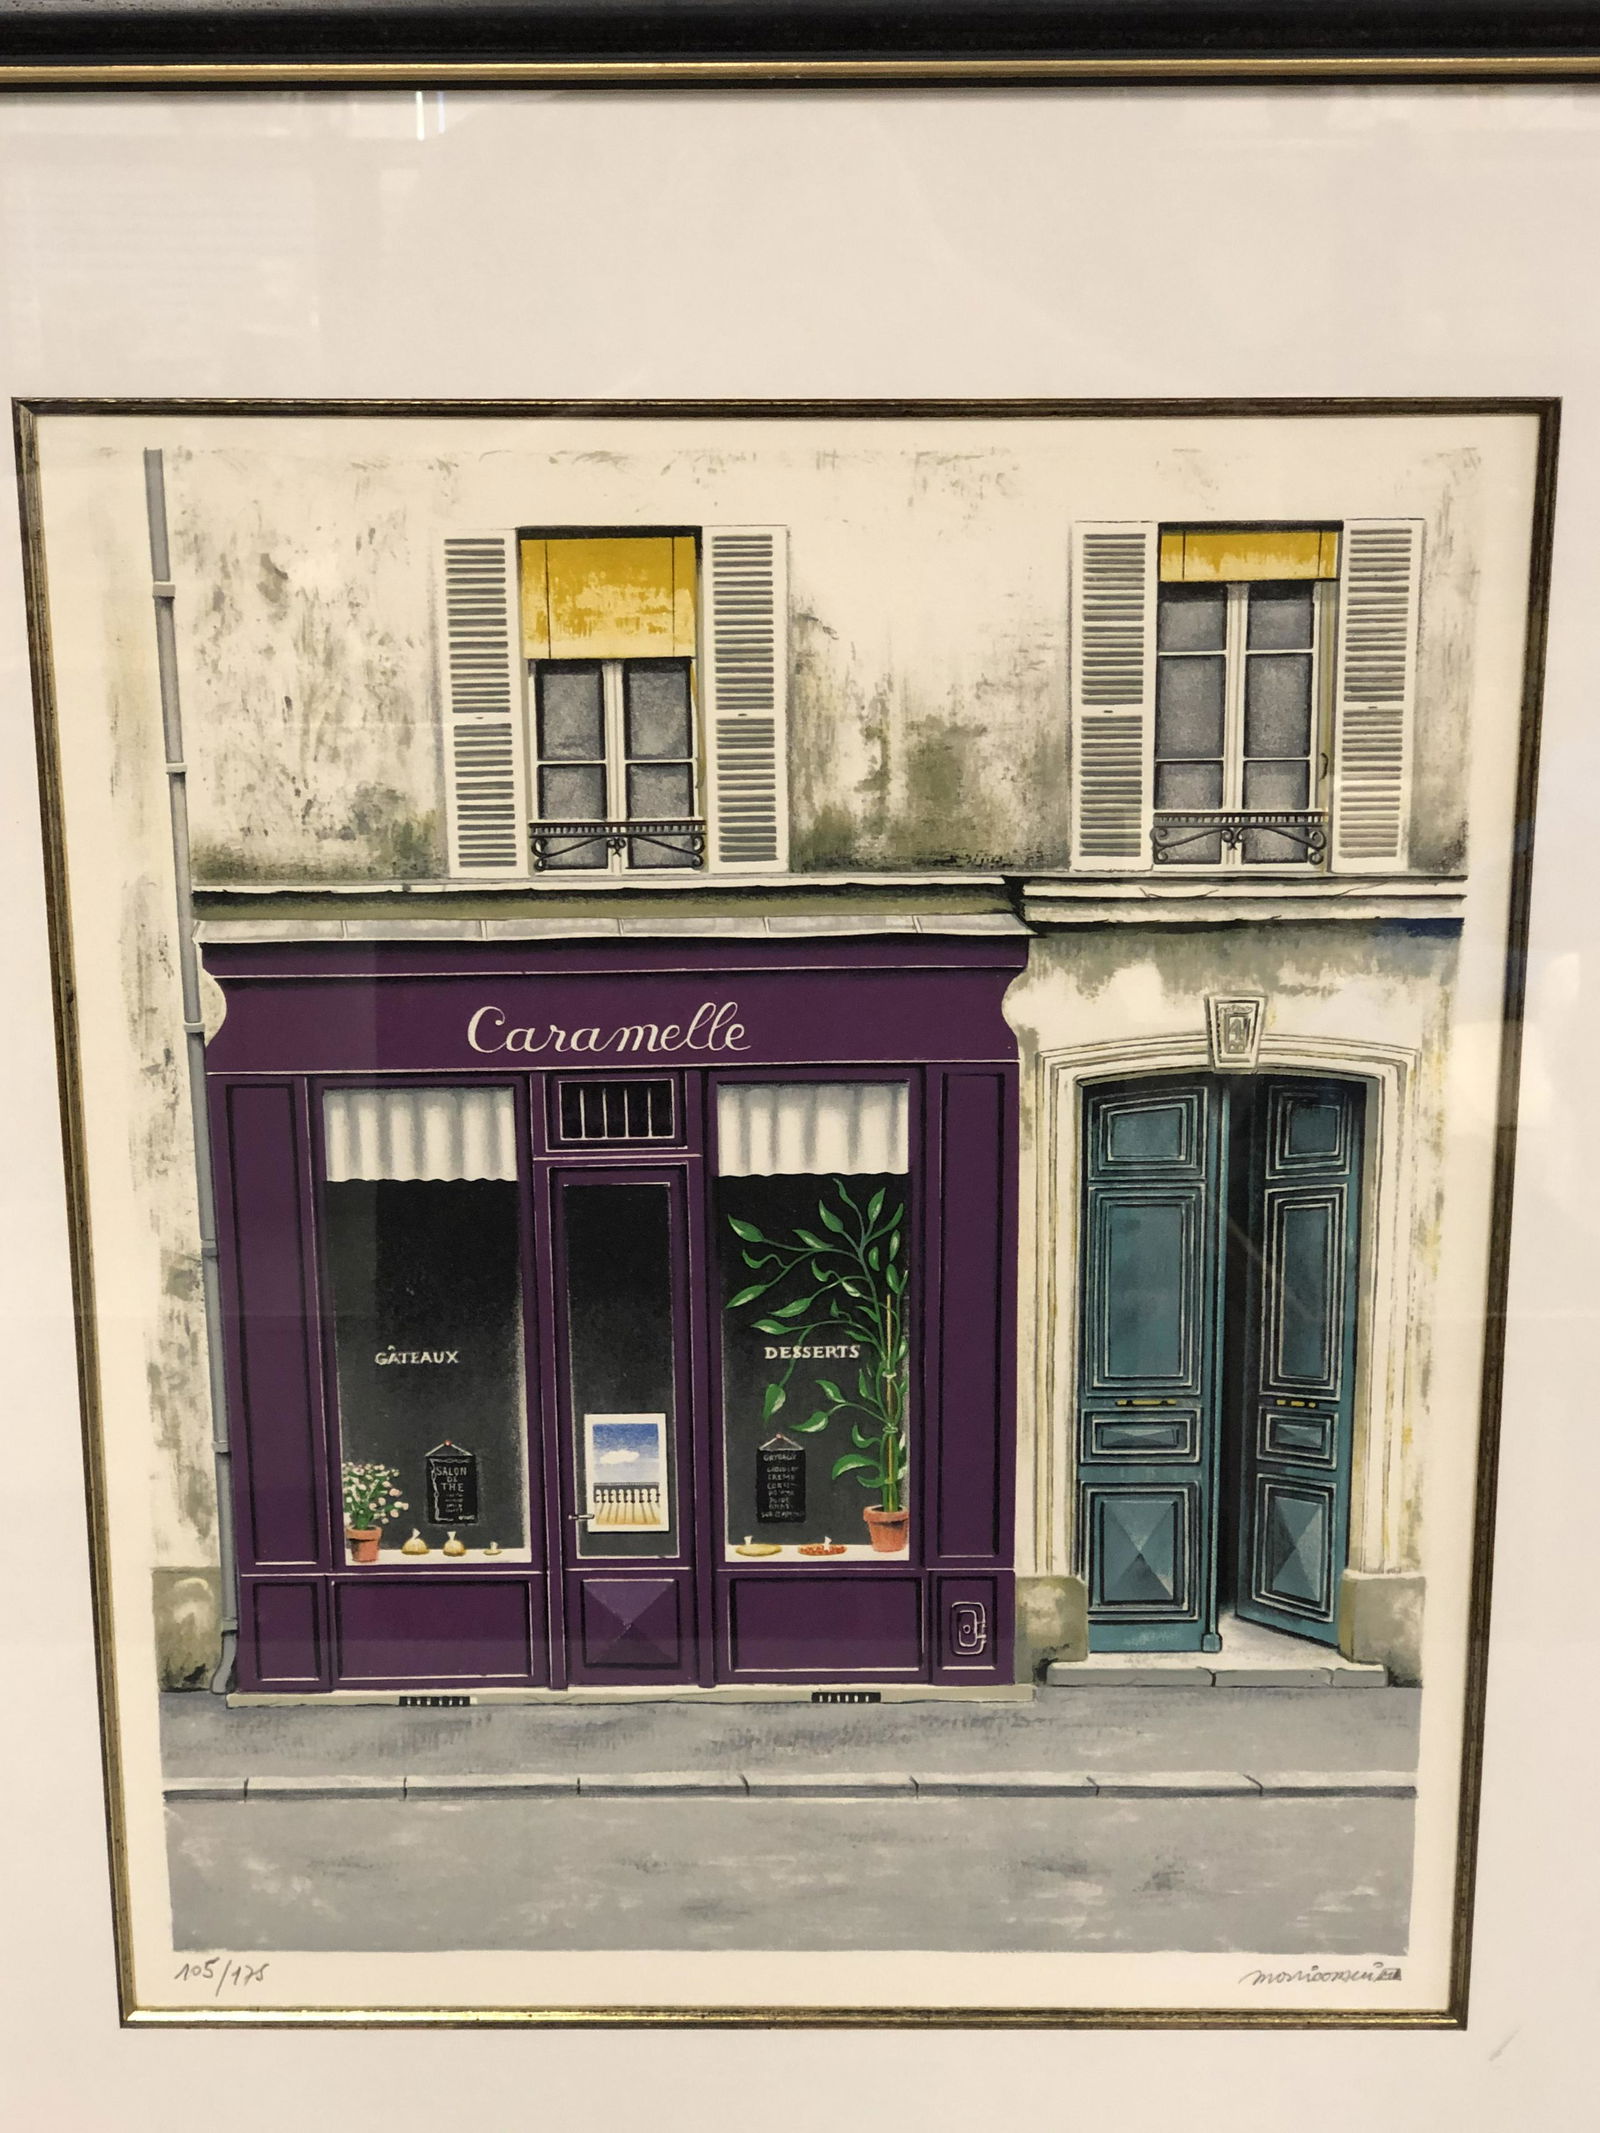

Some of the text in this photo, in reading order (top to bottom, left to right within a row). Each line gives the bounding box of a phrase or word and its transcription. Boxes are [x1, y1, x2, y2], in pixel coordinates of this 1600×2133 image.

[467, 1001, 751, 1053] Caramelle
[375, 1345, 459, 1365] GÂTEAUX
[764, 1344, 861, 1360] DESSERTS
[436, 1467, 467, 1476] SALON
[174, 1957, 270, 1997] 105/175
